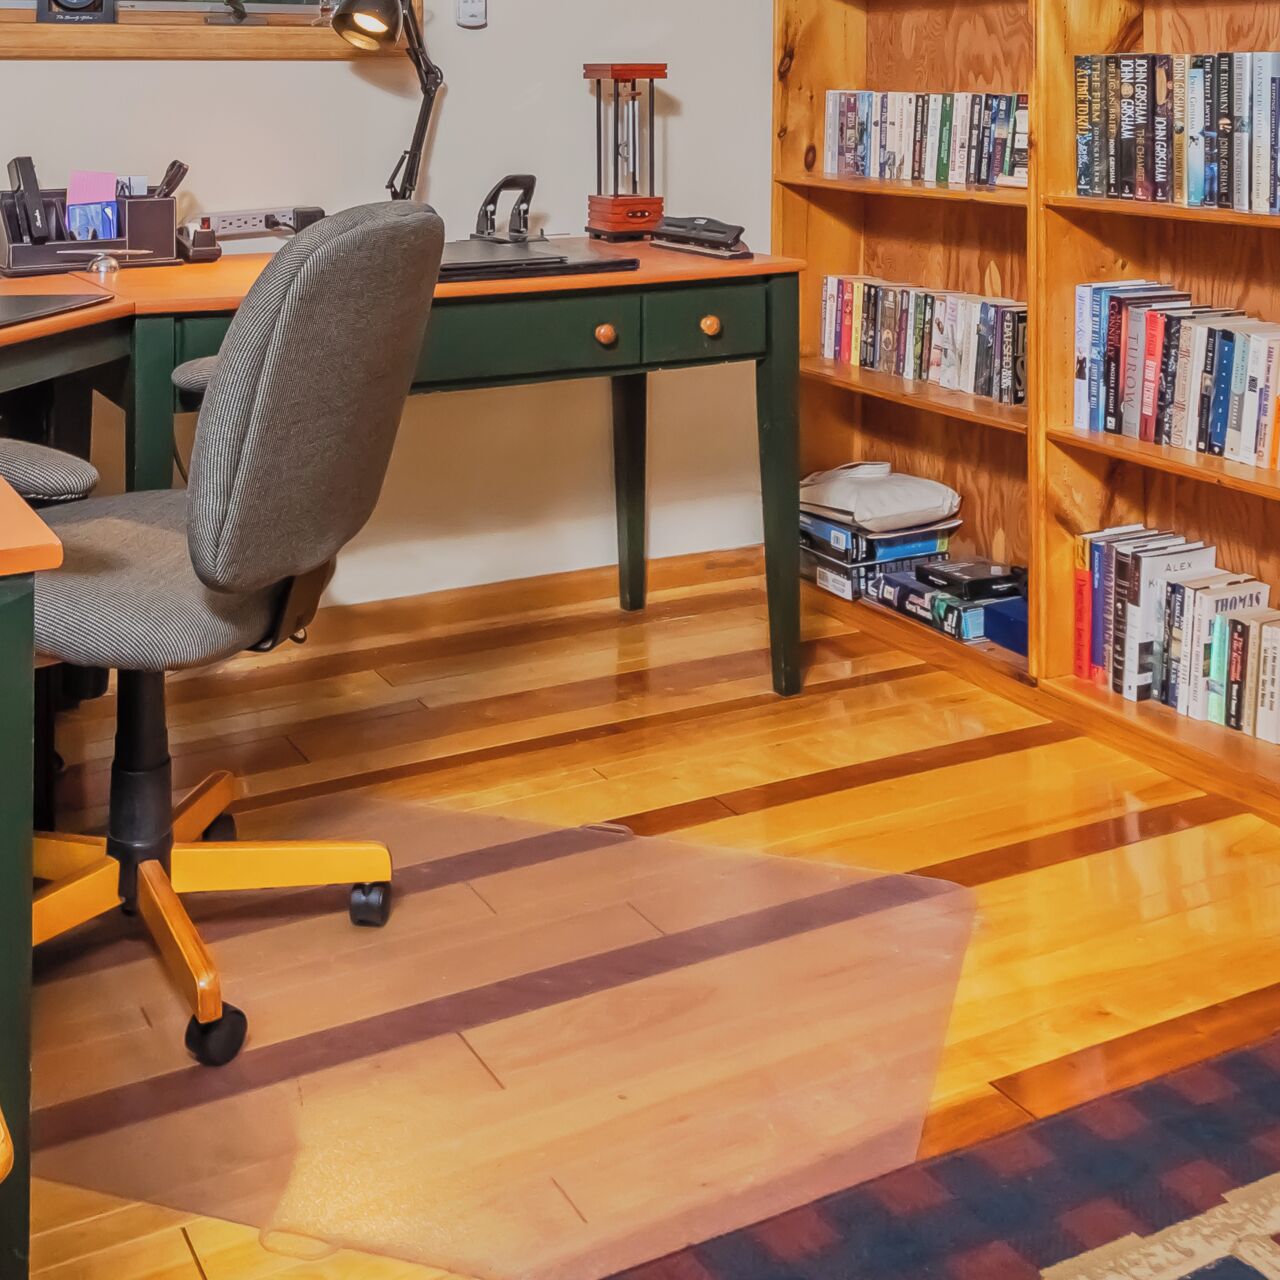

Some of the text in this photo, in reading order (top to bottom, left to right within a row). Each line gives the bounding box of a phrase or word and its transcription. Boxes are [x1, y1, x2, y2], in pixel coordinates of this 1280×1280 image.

[1121, 59, 1134, 138] JOHN GRISHAM
[1174, 58, 1184, 118] JOHN GRISHAM
[1155, 116, 1166, 182] JOHN GRISHAM
[1220, 57, 1229, 193] THE TESTAMENT JOHN GRISHAM
[1003, 322, 1013, 368] DAI-SHO
[1108, 301, 1118, 358] CONNELLY
[1125, 333, 1139, 409] TUROW
[1165, 563, 1193, 571] ALEX
[1215, 591, 1261, 613] THOMAS
